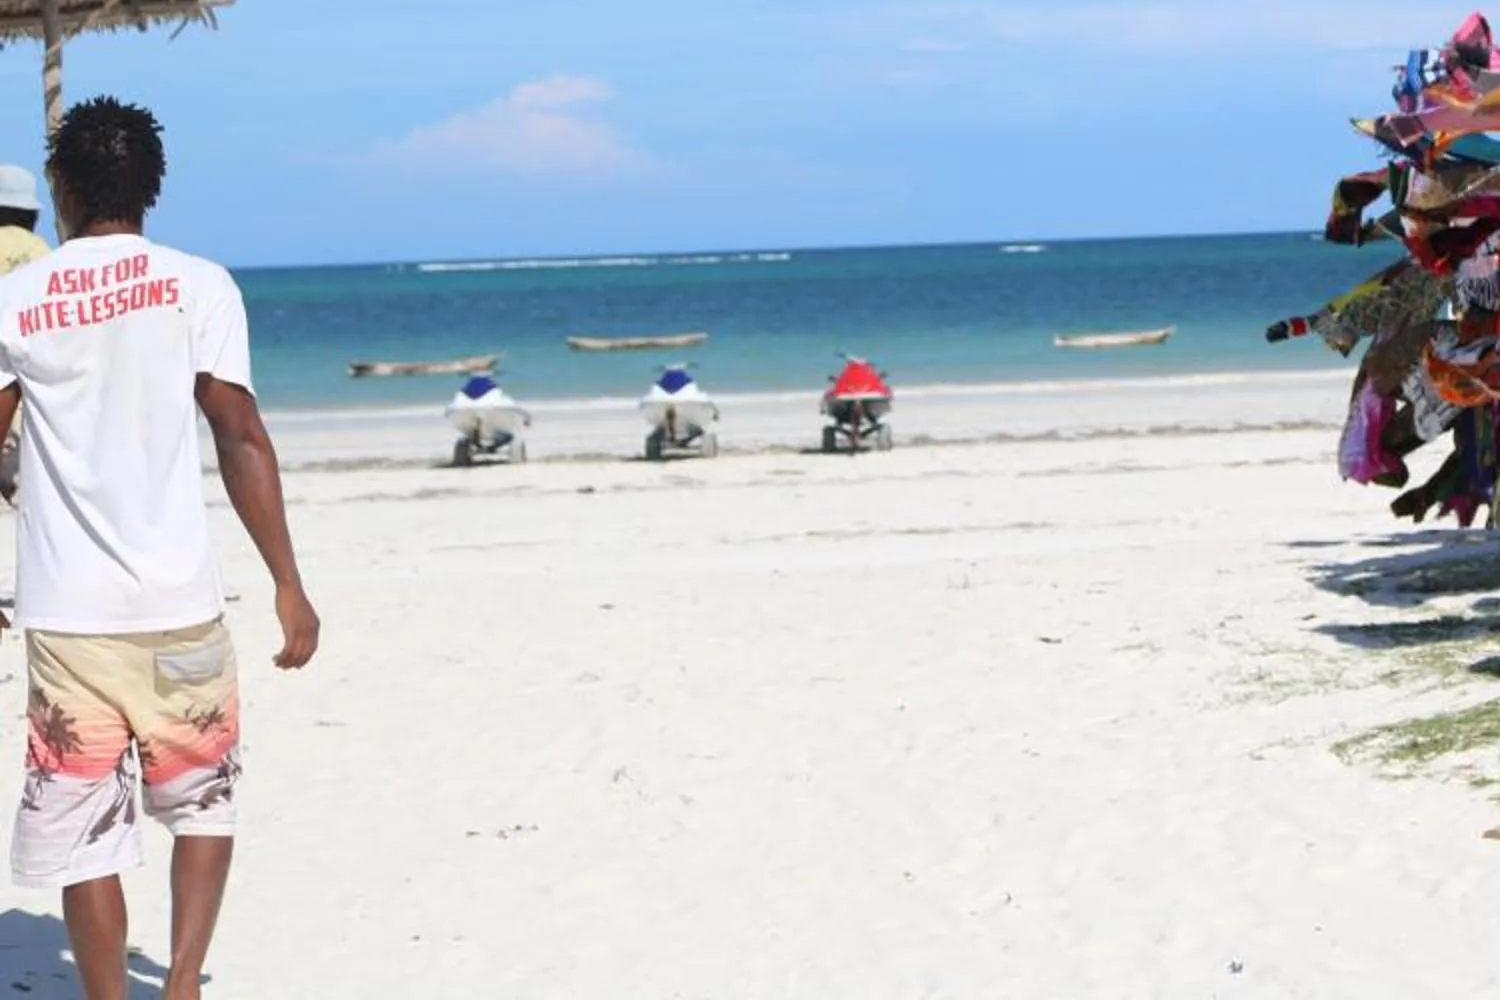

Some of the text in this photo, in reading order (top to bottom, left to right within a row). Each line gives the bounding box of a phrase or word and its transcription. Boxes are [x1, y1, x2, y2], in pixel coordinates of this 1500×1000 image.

[47, 253, 149, 296] ASK FOR
[18, 278, 179, 337] KITE LESSONS
